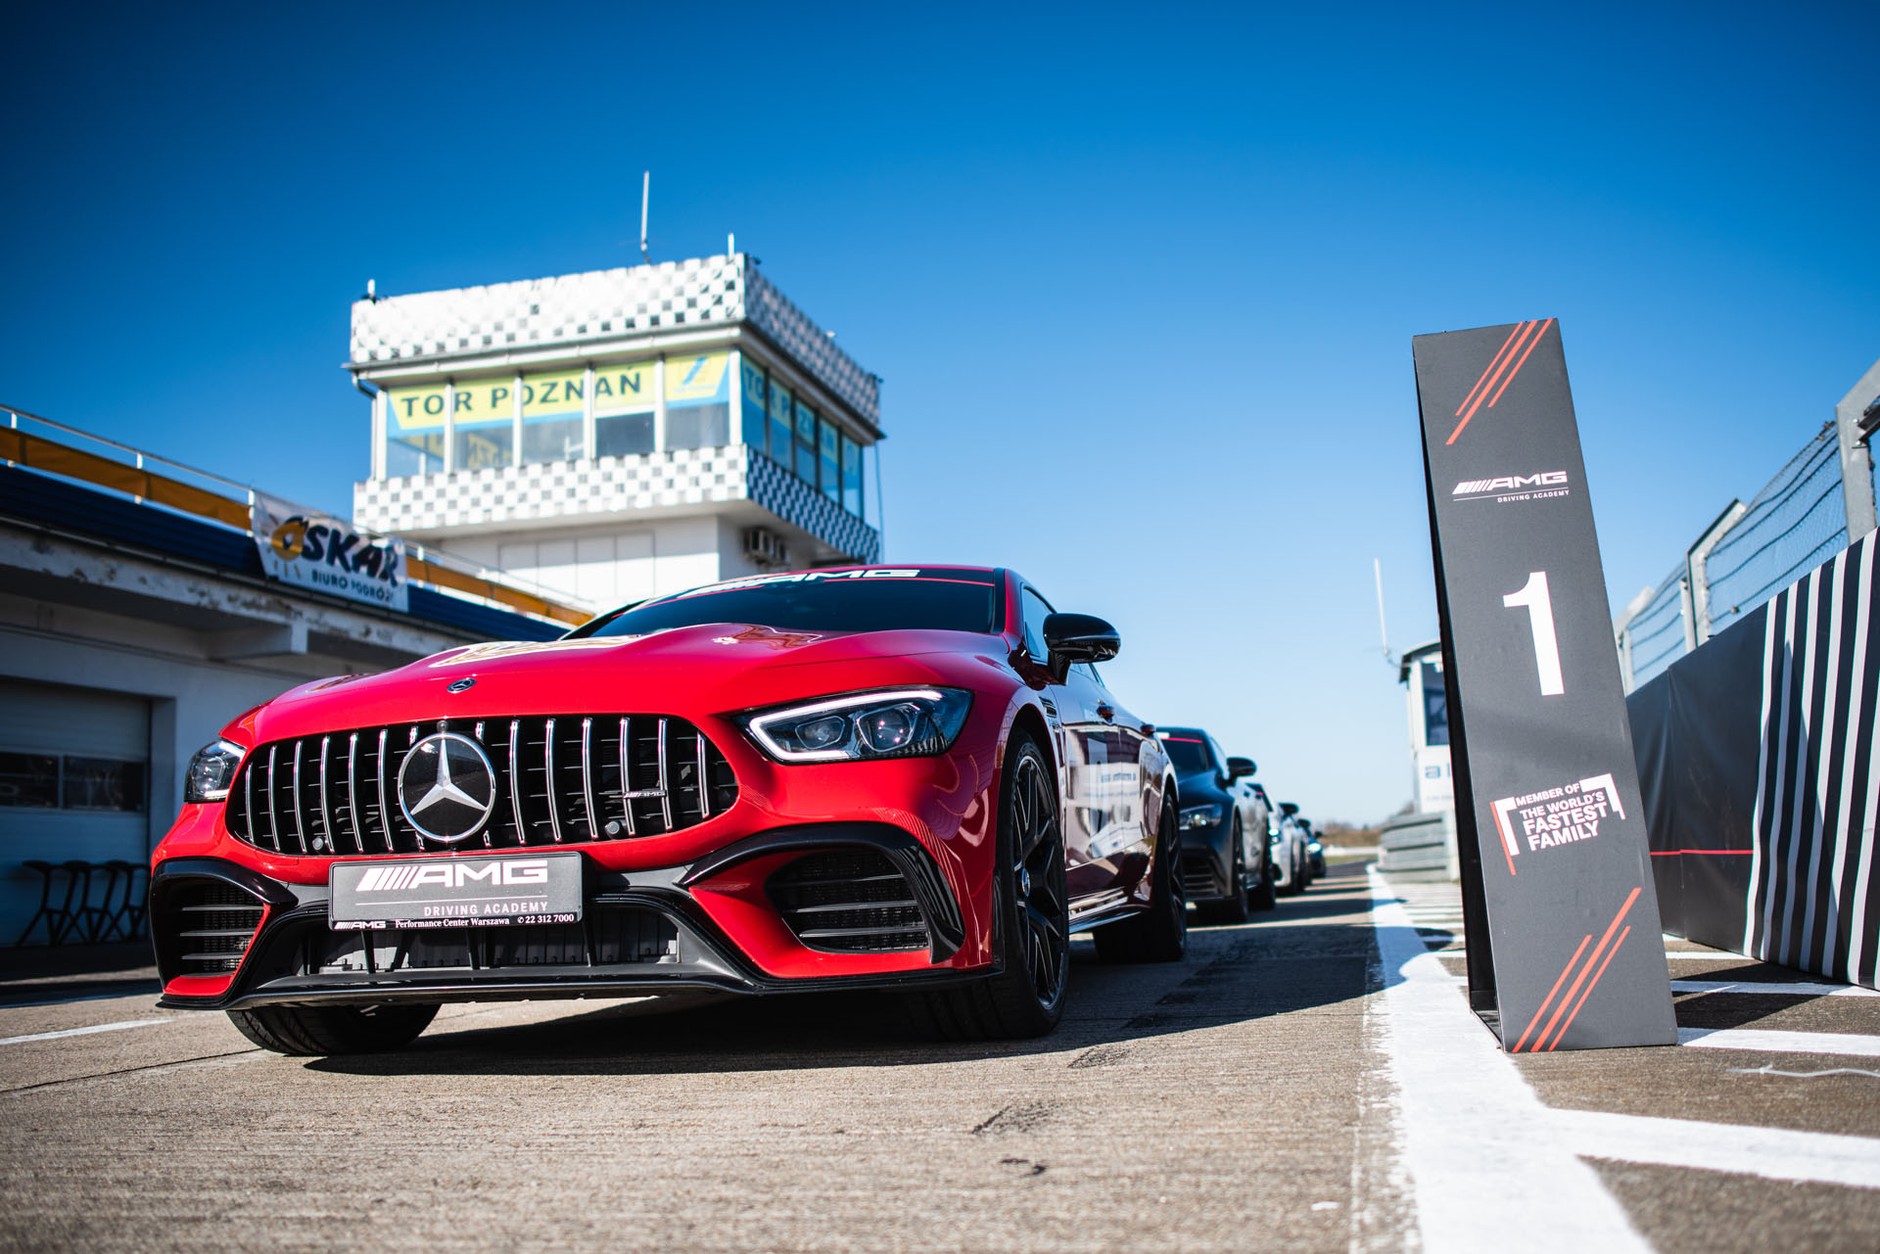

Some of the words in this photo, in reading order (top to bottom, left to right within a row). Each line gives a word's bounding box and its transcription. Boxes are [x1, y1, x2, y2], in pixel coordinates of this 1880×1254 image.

[401, 391, 473, 418] TOR
[491, 366, 642, 409] POZNAŃ
[1486, 470, 1568, 491] AMG
[1497, 493, 1530, 503] DRIVING
[1533, 489, 1570, 499] ACADEMY
[271, 516, 398, 588] OSKAR
[311, 570, 348, 589] BIURO
[762, 569, 920, 584] AMG
[1503, 571, 1565, 696] 1
[1515, 787, 1564, 806] MEMBER
[1565, 782, 1580, 795] OF
[1520, 806, 1546, 820] THE
[1522, 802, 1608, 835] FASTEST
[1527, 820, 1599, 851] FAMILY
[408, 860, 548, 889] AMG
[424, 903, 478, 916] DRIVING
[484, 901, 548, 914] ACADEMY
[351, 921, 386, 929] AMG
[395, 919, 442, 929] Performance
[443, 918, 468, 927] Center
[470, 917, 510, 926] Warszawa
[525, 915, 535, 924] 22
[538, 914, 552, 923] 312
[553, 913, 574, 923] 7000
